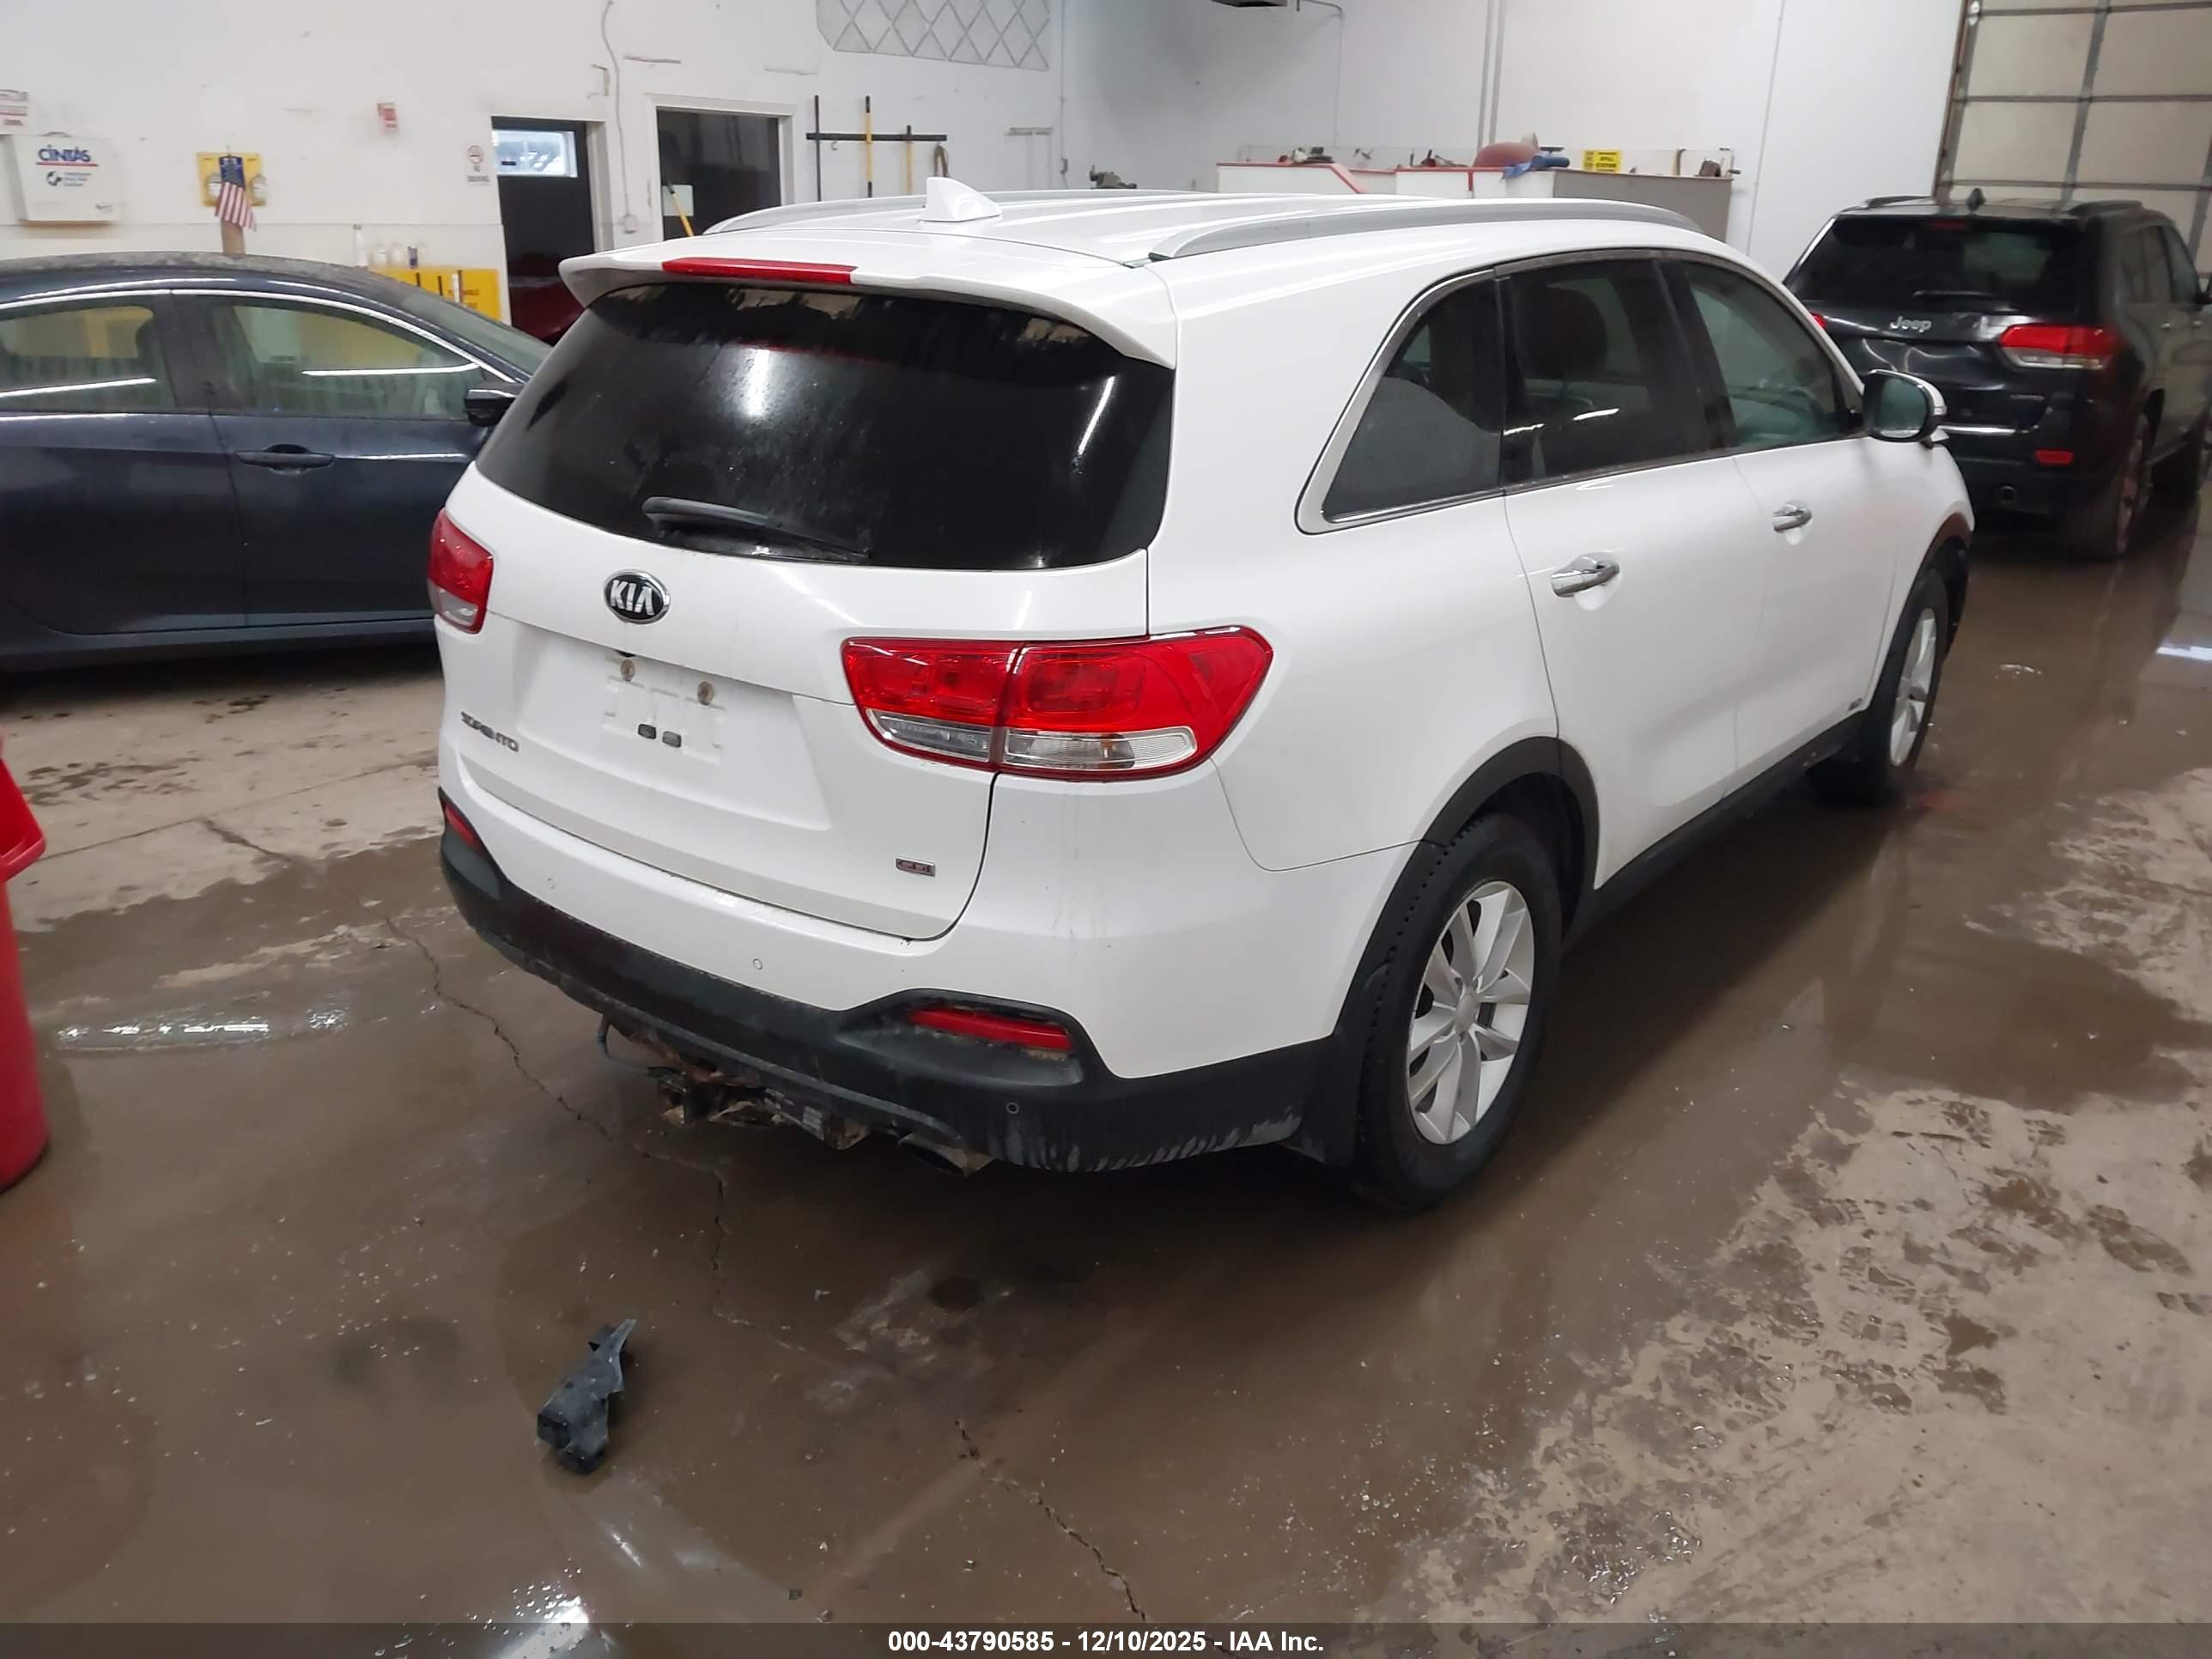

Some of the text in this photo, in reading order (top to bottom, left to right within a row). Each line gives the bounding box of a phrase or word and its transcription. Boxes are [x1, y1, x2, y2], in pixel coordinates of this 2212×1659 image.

[37, 144, 92, 163] CINTAS
[1890, 316, 1932, 333] Jeep
[610, 579, 655, 617] KIA
